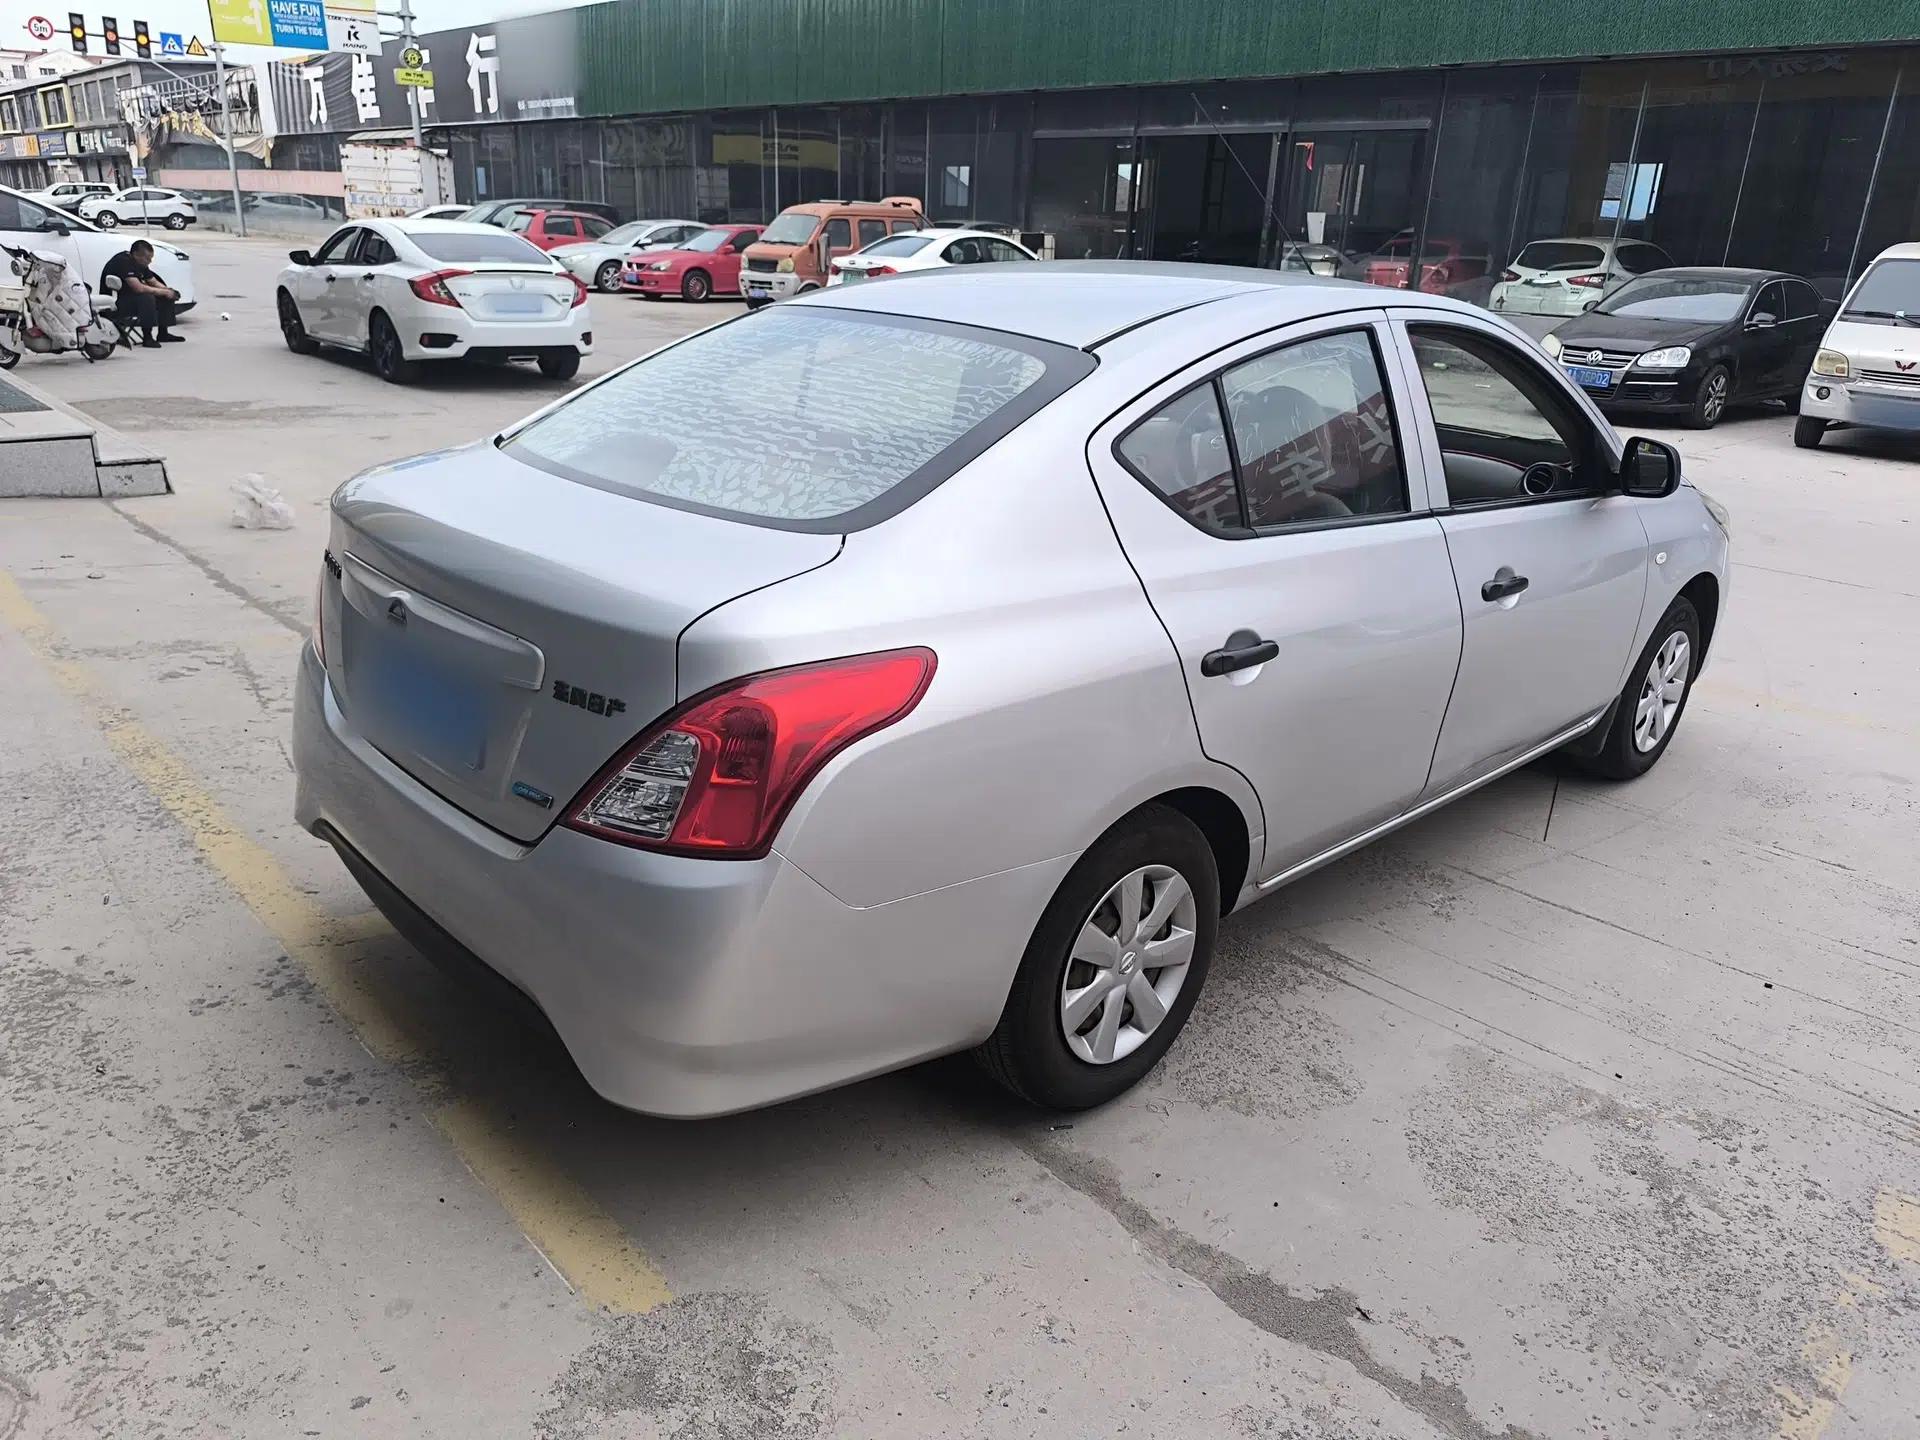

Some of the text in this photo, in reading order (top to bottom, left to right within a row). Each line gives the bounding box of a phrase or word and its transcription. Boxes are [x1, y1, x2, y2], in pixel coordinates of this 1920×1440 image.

[271, 1, 299, 14] HAVE
[299, 3, 321, 18] FUN
[33, 23, 48, 33] 5m
[275, 23, 295, 34] TURN
[294, 25, 308, 35] THE
[308, 26, 324, 37] TIDE
